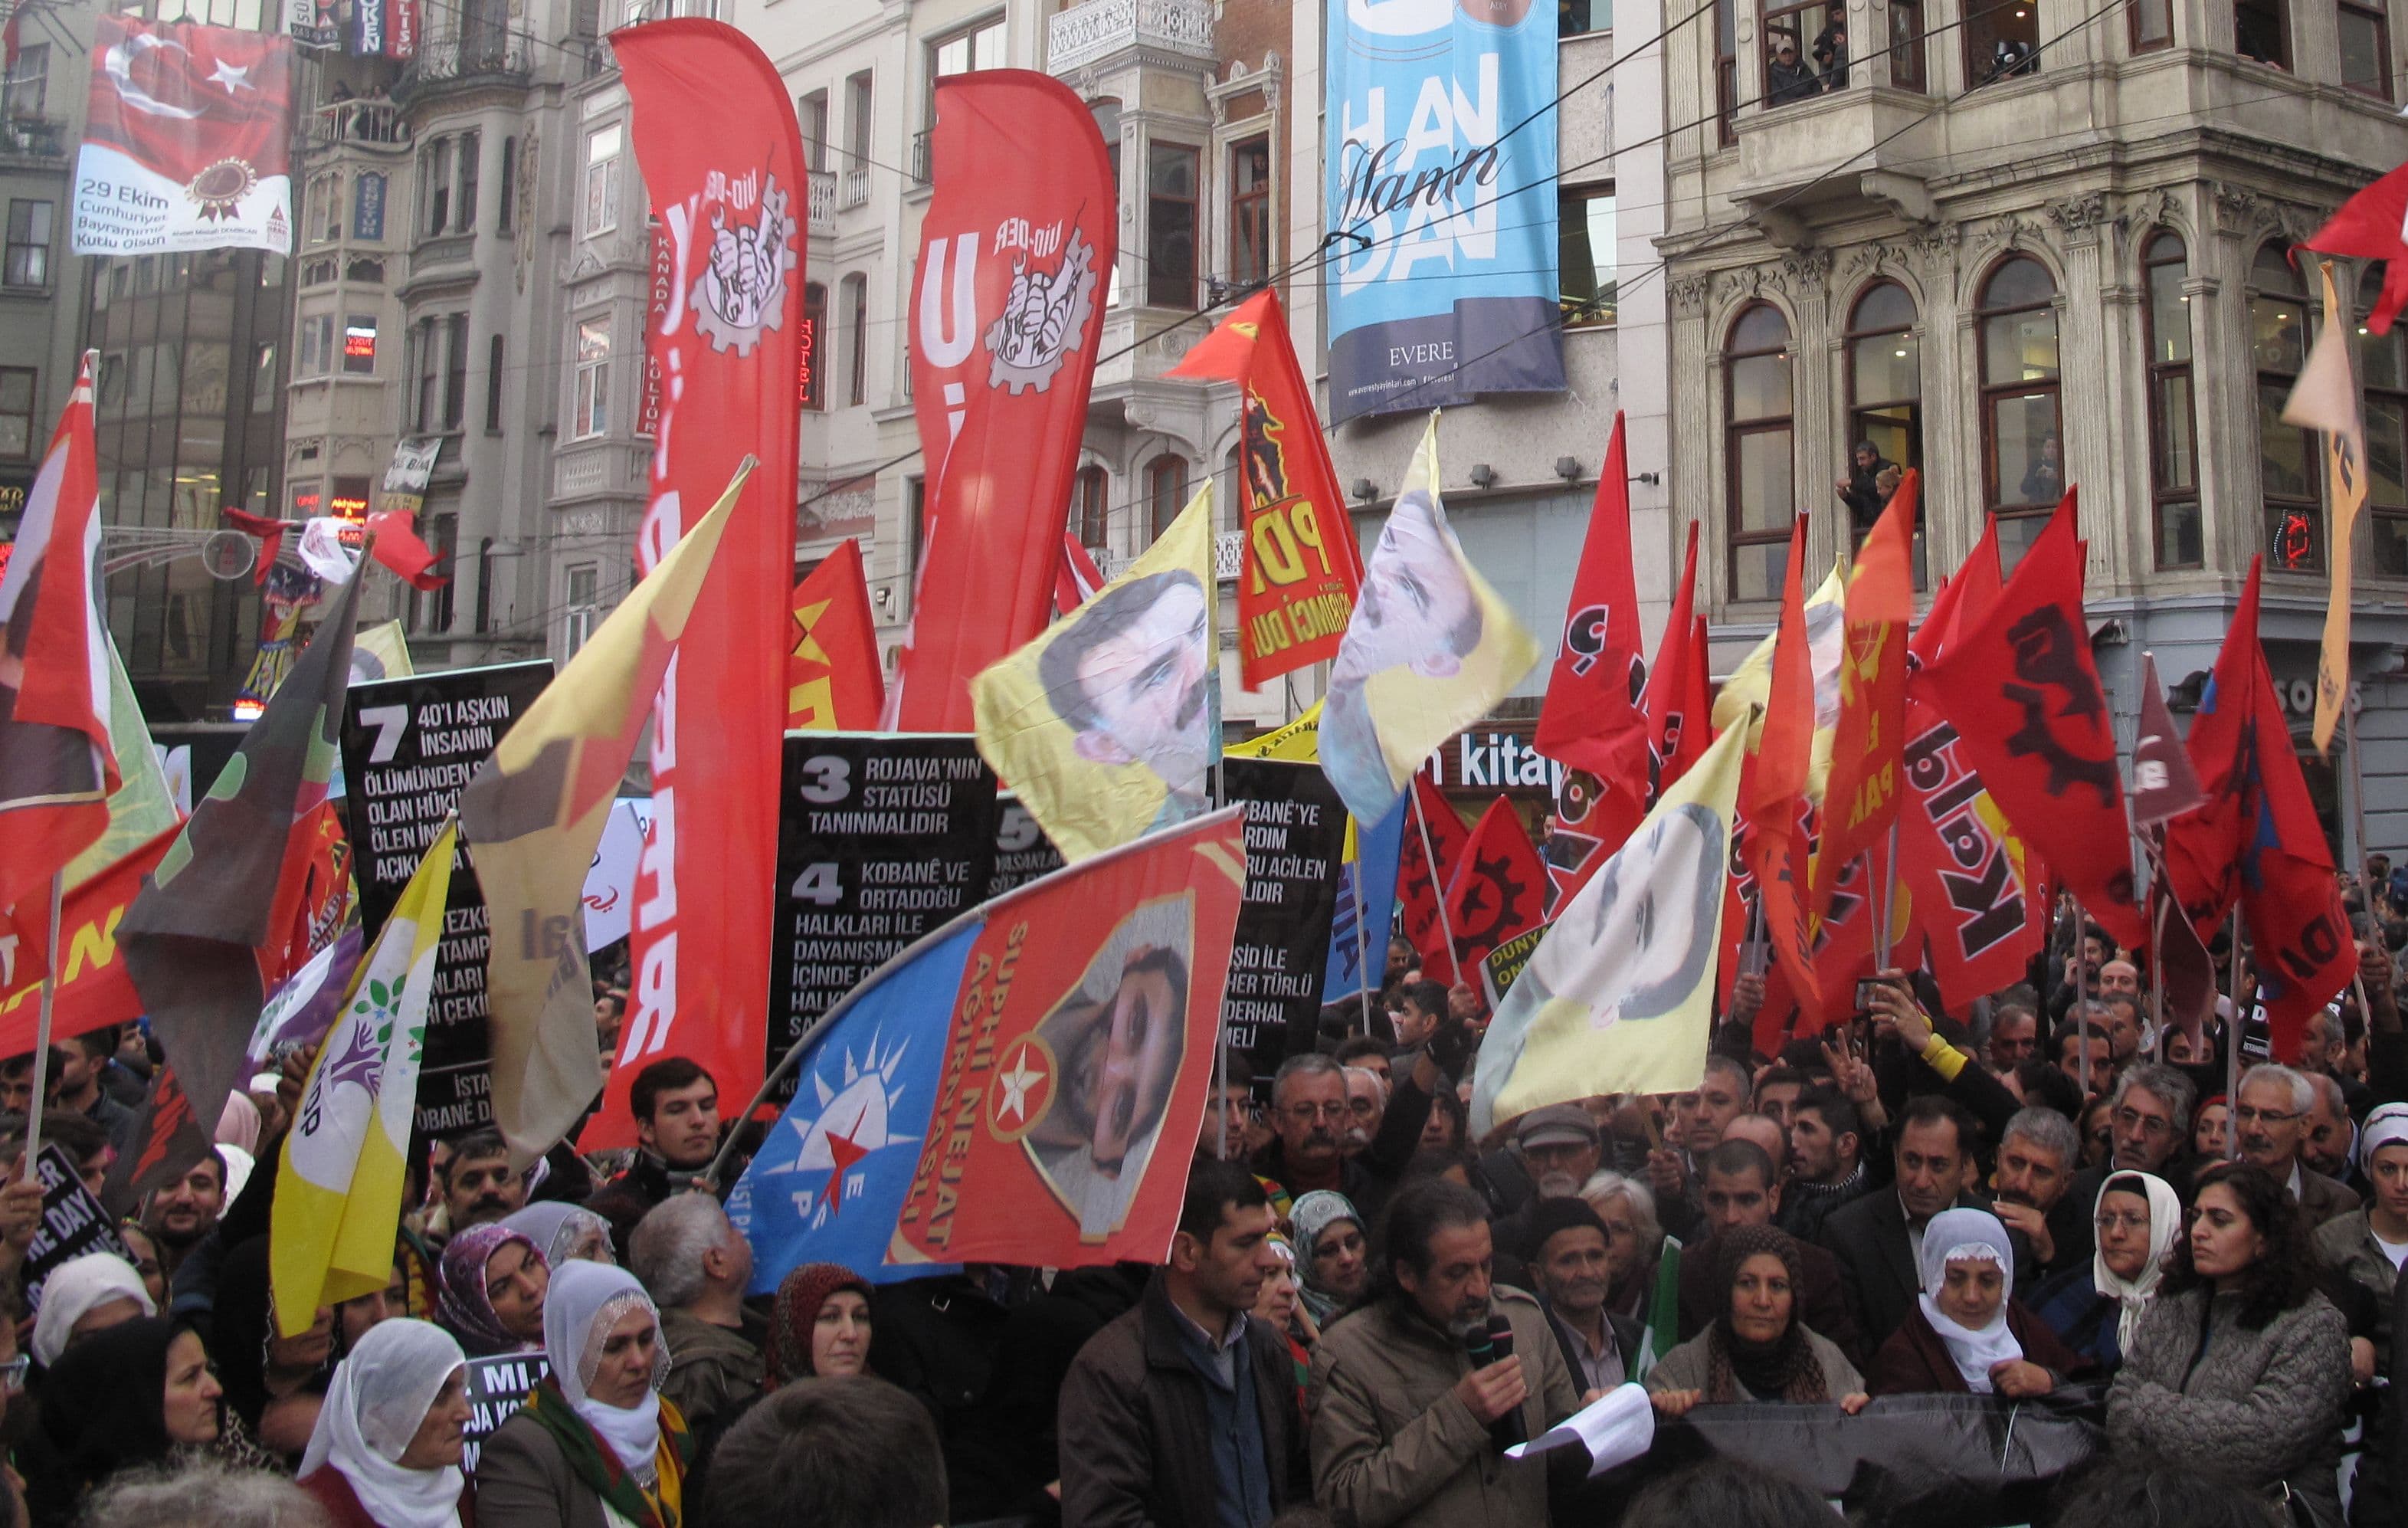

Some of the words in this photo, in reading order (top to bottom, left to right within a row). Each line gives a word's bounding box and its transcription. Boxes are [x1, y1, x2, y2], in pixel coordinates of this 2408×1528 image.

[81, 179, 112, 198] 29
[119, 185, 169, 210] Ekim
[654, 236, 671, 313] KANADA
[359, 703, 410, 764] 7
[456, 694, 511, 726] AŞKIN
[420, 726, 495, 757] İNSANIN
[364, 762, 472, 798] ÖLÜMÜNDEN
[801, 756, 850, 803] 3
[865, 757, 983, 780] ROJAVA'NIN
[863, 782, 952, 808] STATÜSÜ
[368, 798, 414, 825] OLAN
[809, 811, 949, 834] TANINMALIDIR
[371, 823, 416, 854] ÖLEN
[996, 807, 1040, 851] 5
[791, 862, 844, 906] 4
[862, 858, 941, 884] KOBANÊ
[945, 861, 971, 883] VE
[1268, 855, 1327, 880] ACİLEN
[860, 884, 962, 910] ORTADOĞU
[795, 913, 892, 936] HALKLARI
[895, 910, 924, 935] İLE
[794, 939, 906, 964] DAYANIŞMA
[1262, 943, 1288, 971] İLE
[792, 963, 855, 989] İÇİNDE
[1262, 972, 1313, 998] TÜRLÜ
[968, 920, 1029, 1073] SUPHİ
[926, 1087, 982, 1252] NEJAT
